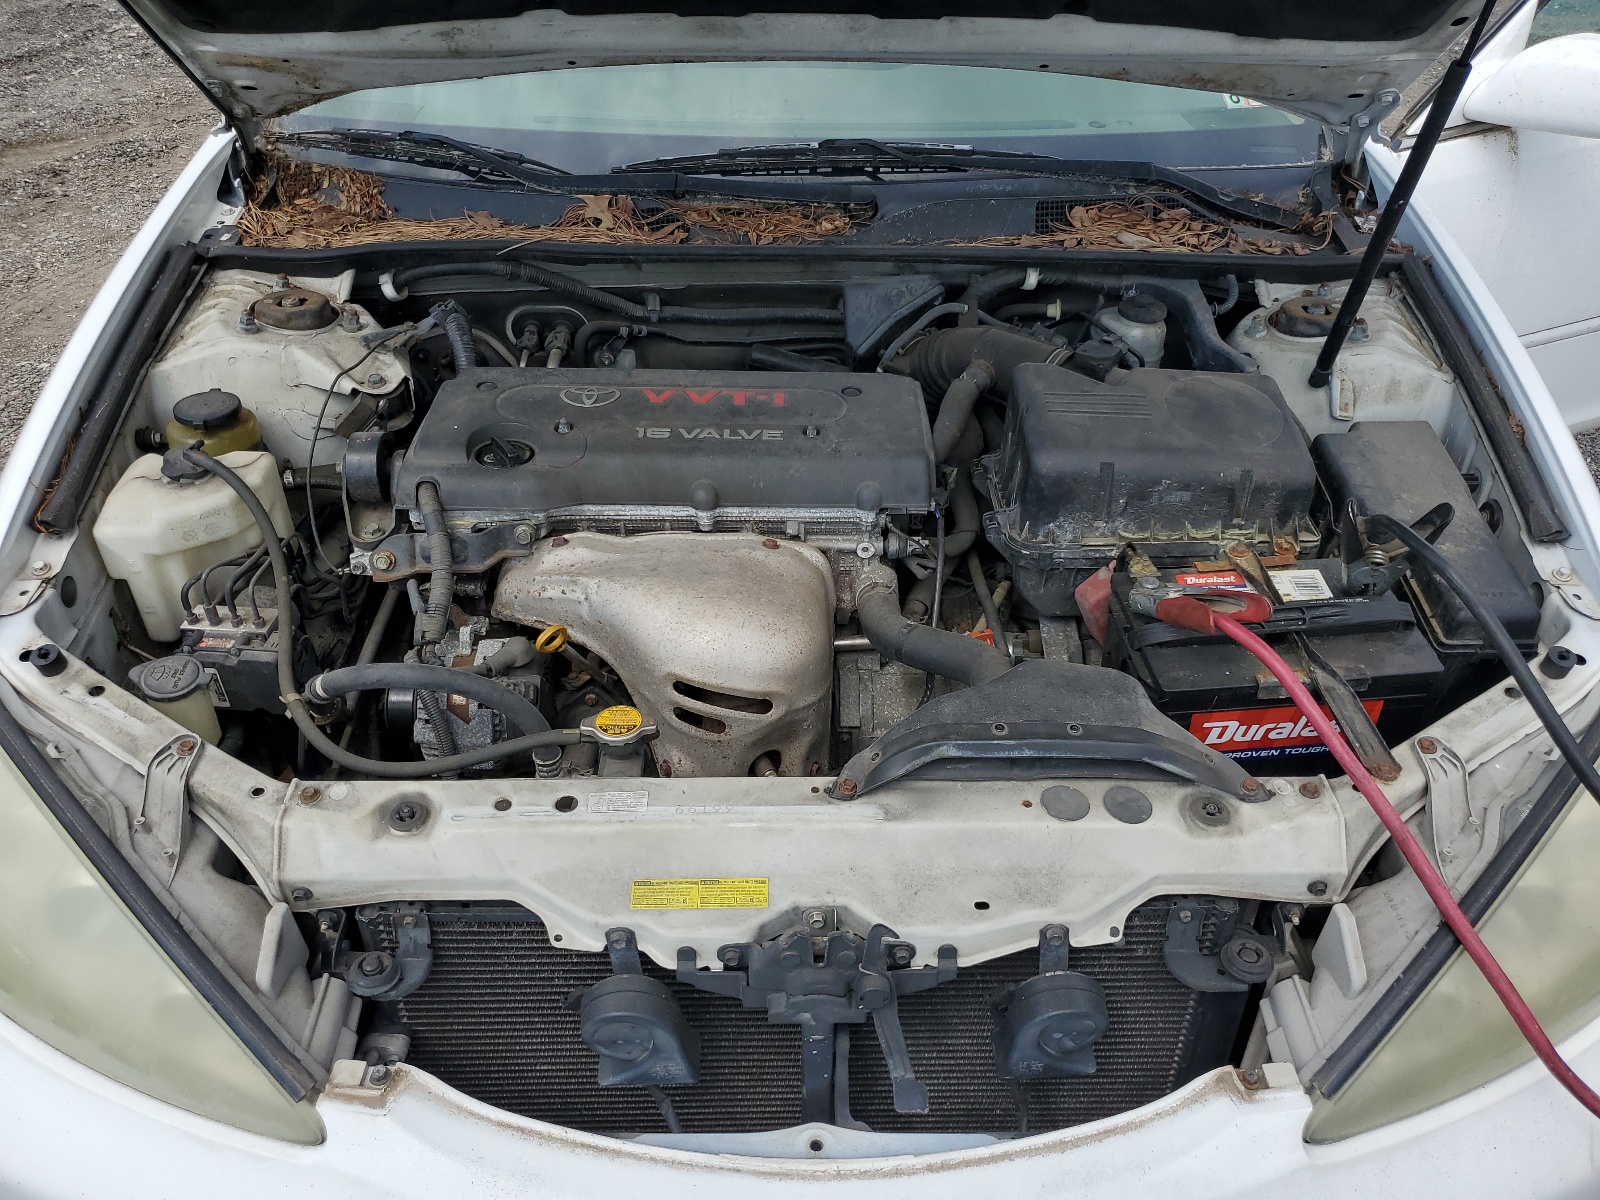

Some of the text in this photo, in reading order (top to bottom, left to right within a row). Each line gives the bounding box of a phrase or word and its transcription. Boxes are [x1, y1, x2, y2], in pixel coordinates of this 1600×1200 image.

[635, 427, 784, 441] 16 VALVE
[1183, 575, 1236, 584] Duralast
